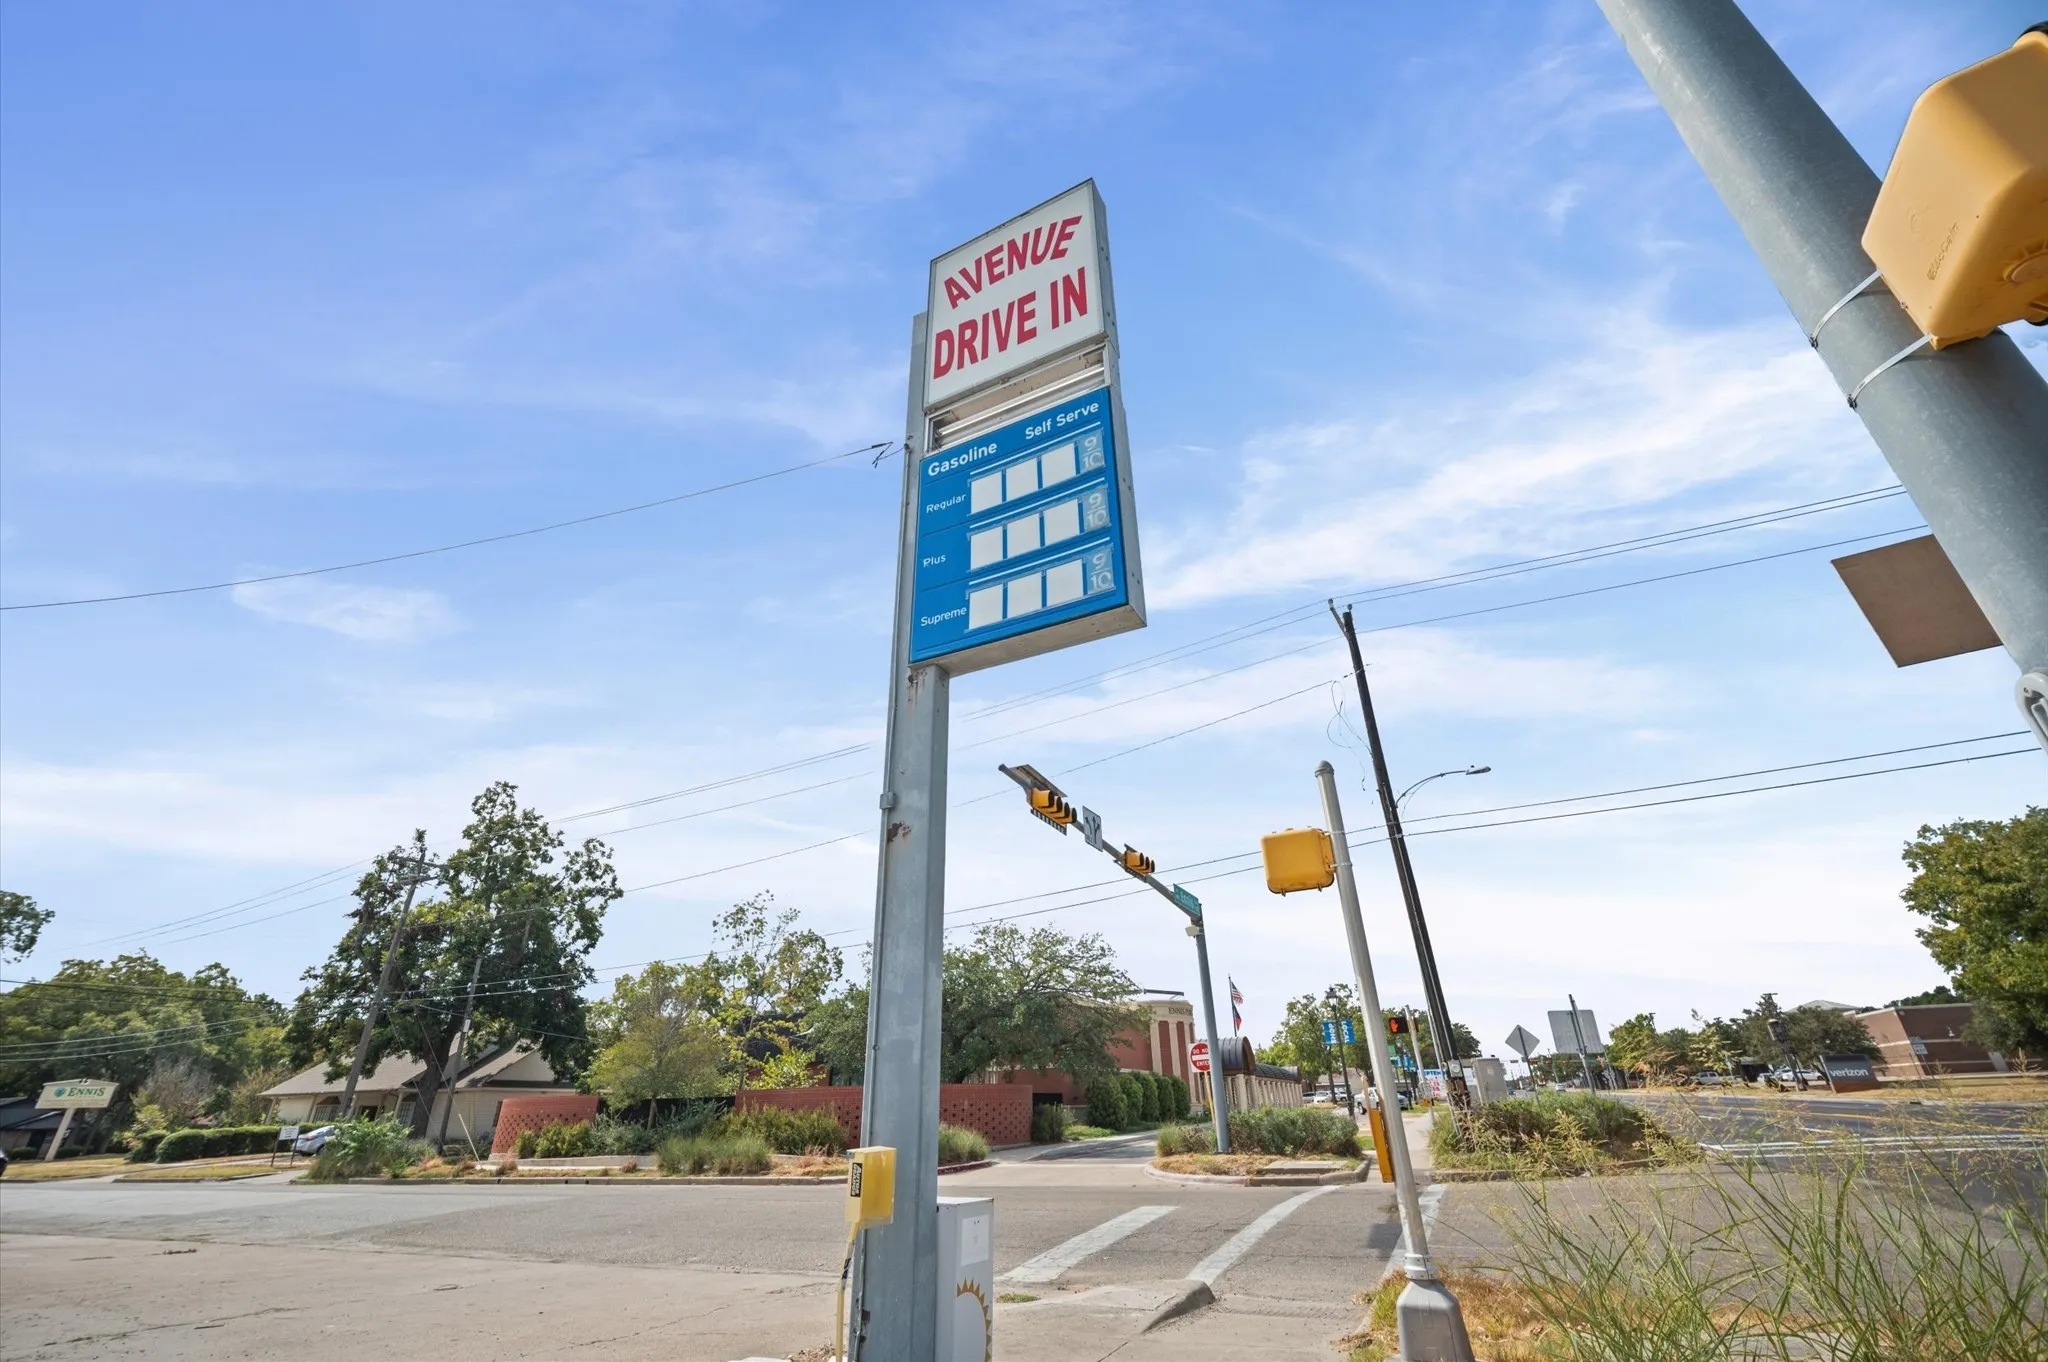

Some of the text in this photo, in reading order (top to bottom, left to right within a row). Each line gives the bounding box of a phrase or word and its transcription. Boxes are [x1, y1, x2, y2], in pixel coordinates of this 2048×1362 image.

[944, 215, 1083, 310] AVENUE
[933, 266, 1088, 380] DRIVE IN
[1025, 402, 1099, 440] Self Serve
[1084, 436, 1097, 449] 9
[928, 442, 998, 477] Gasoline
[1083, 452, 1102, 470] 10
[926, 492, 967, 514] Regular
[1088, 493, 1101, 506] 9
[1088, 508, 1107, 527] 10
[923, 553, 947, 568] Plus
[1091, 571, 1112, 590] 10
[920, 605, 967, 627] Supreme
[1829, 1067, 1869, 1077] verizon
[67, 1086, 106, 1097] ENNIS
